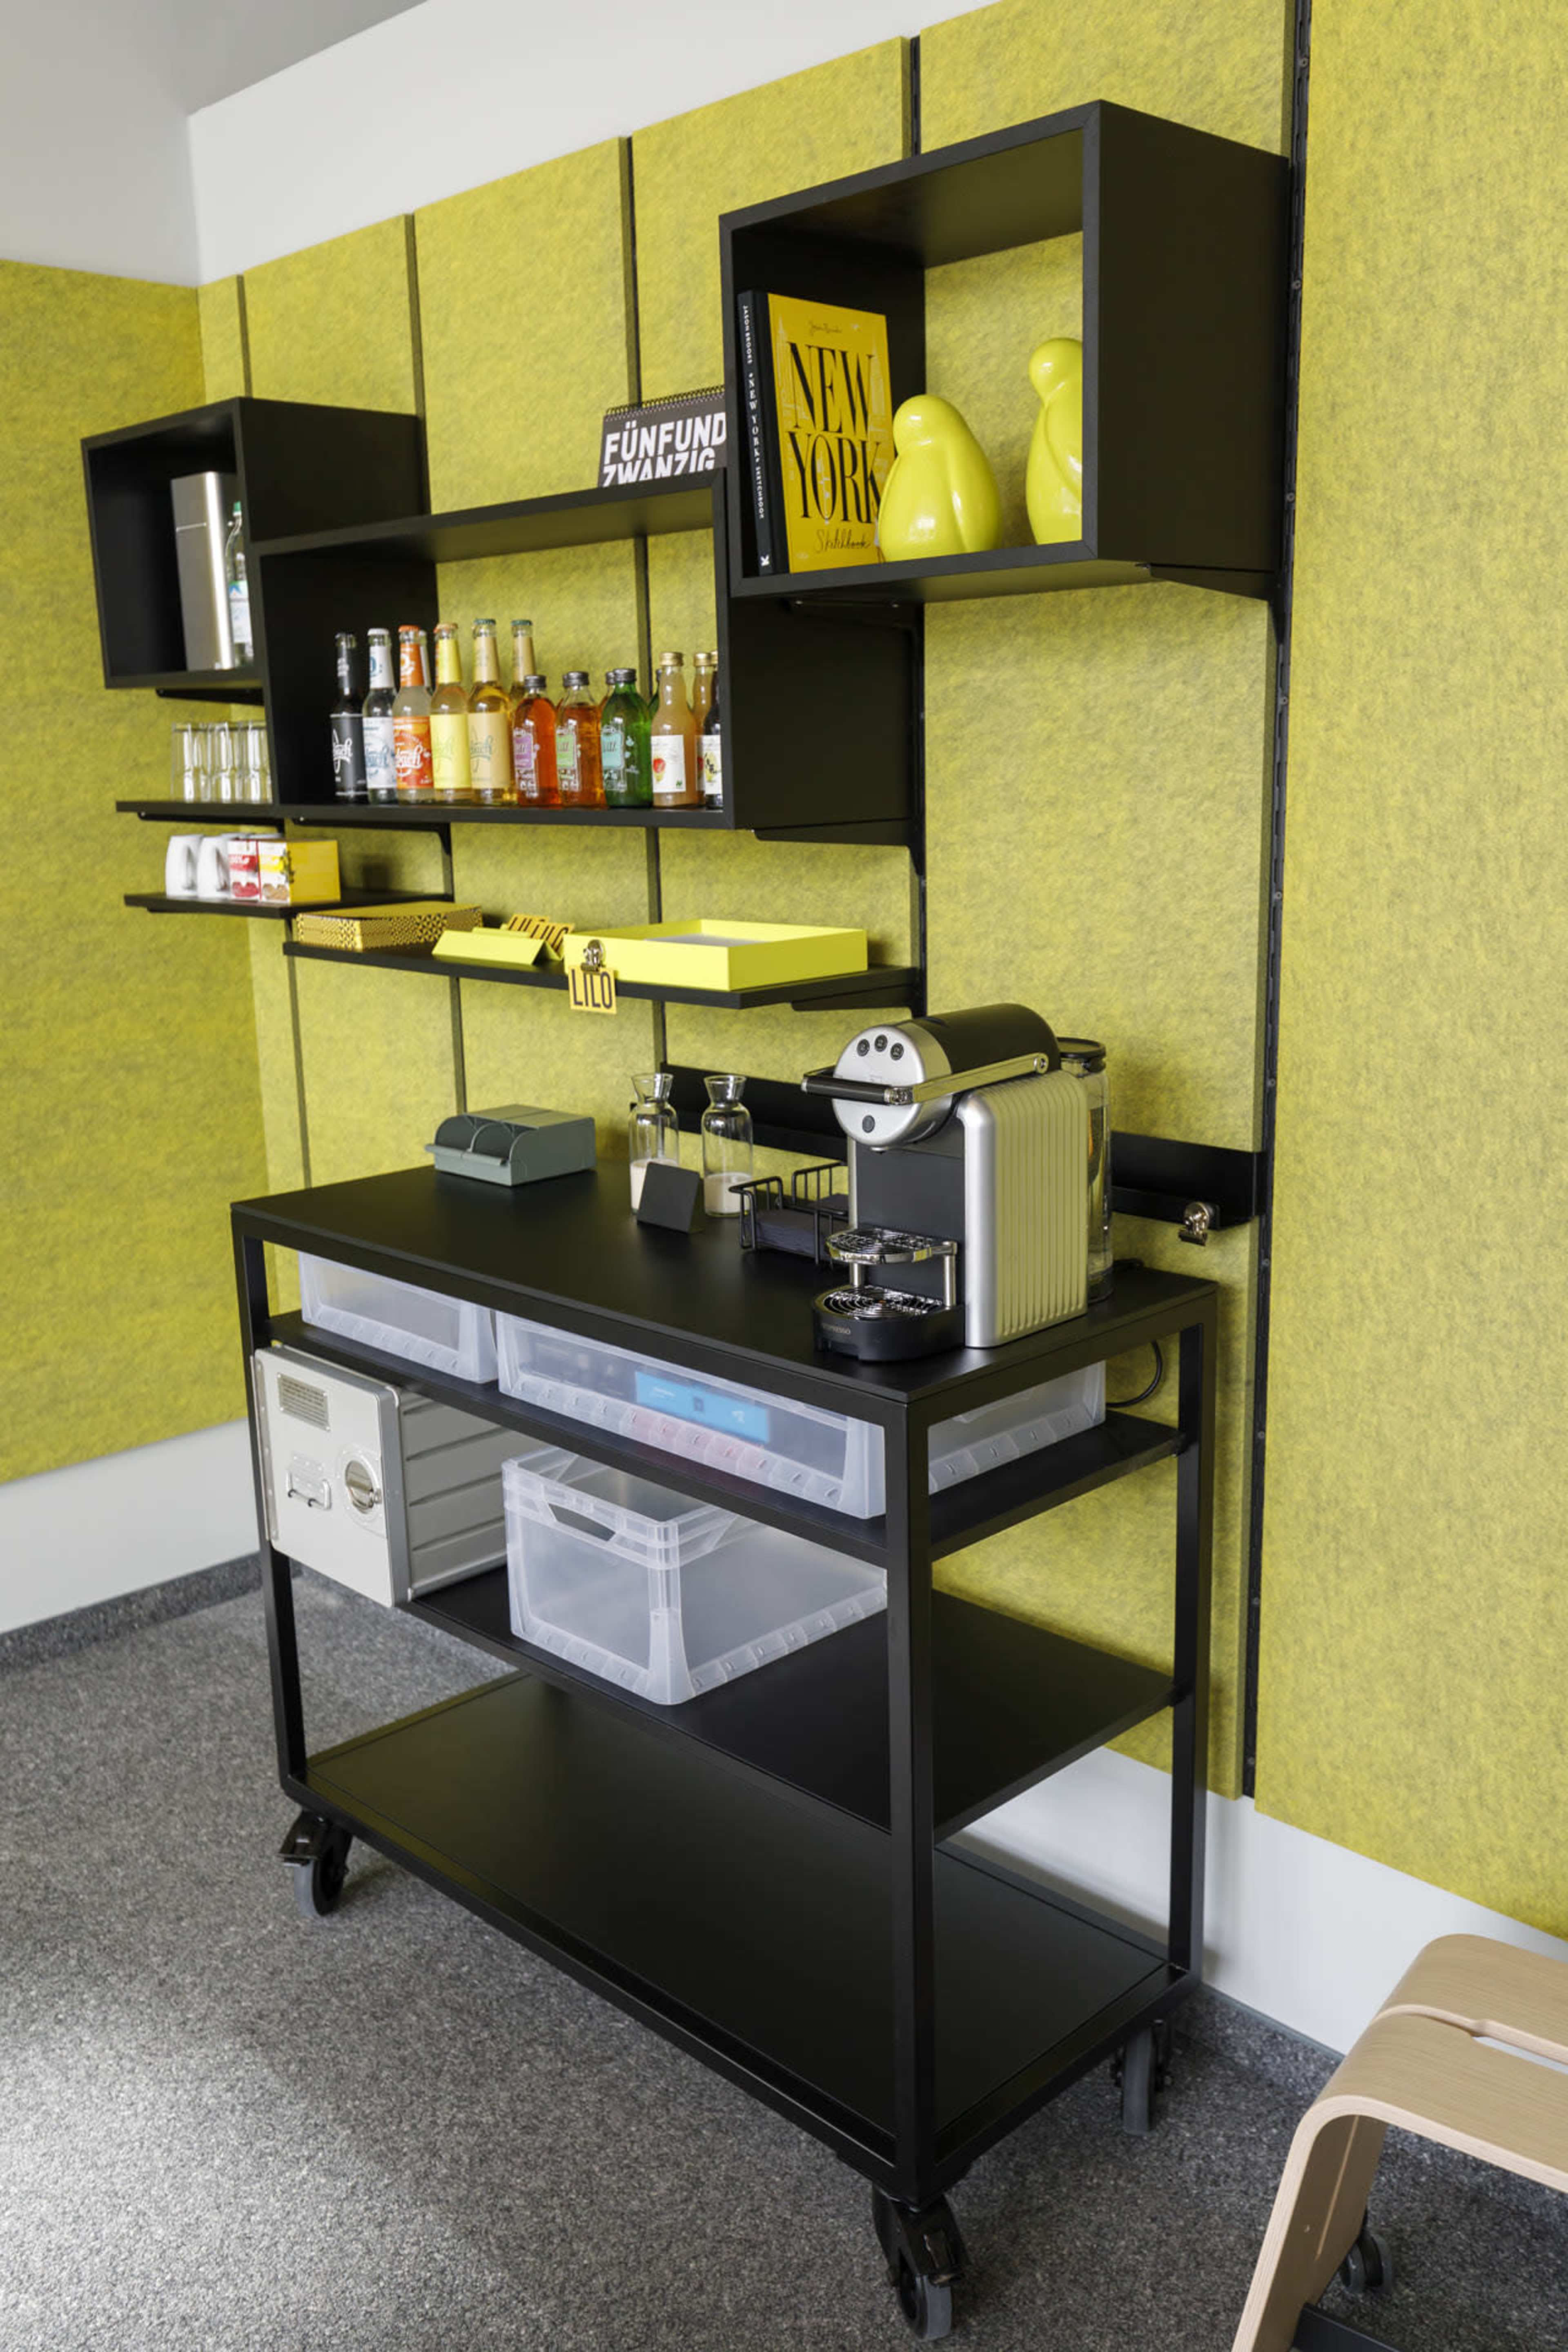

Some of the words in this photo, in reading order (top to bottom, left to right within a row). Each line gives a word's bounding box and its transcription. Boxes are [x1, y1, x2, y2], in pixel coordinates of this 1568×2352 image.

[748, 379, 757, 409] NEW
[786, 341, 875, 442] NEW
[604, 412, 726, 465] FÜNFUND
[751, 415, 760, 458] YORK
[785, 430, 882, 524] YORK
[816, 528, 871, 554] Sketchbook
[571, 968, 612, 1009] LILO
